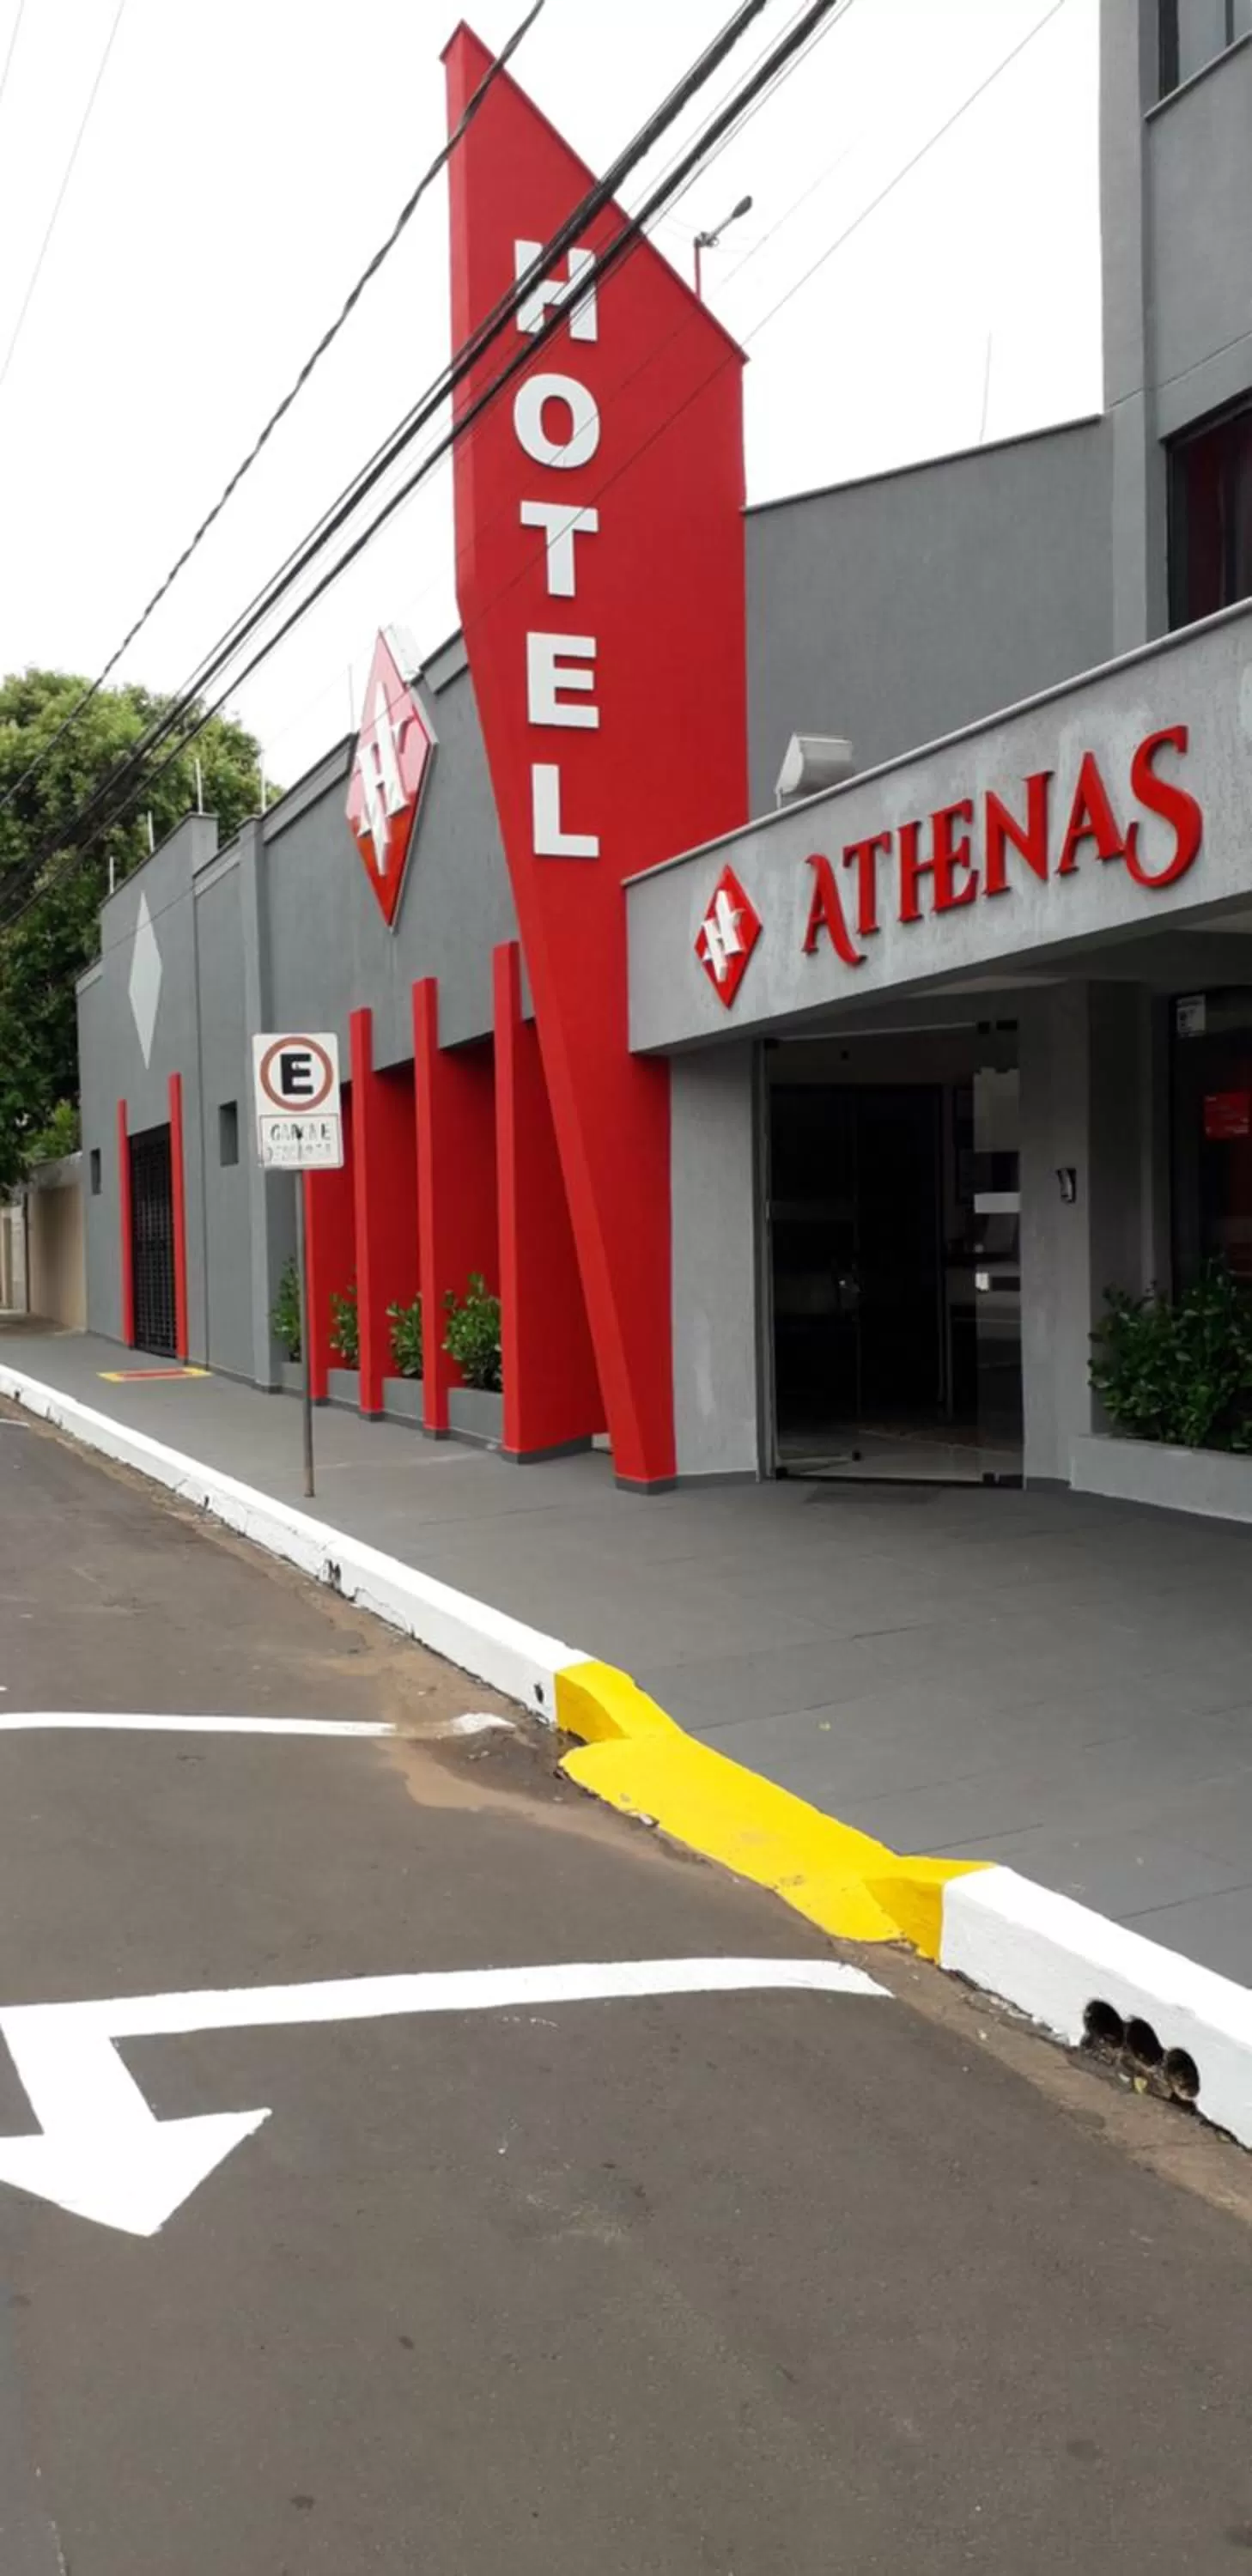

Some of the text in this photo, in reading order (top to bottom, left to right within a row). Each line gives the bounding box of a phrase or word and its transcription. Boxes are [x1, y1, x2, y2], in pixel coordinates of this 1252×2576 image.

[514, 240, 601, 859] HOTEL
[802, 725, 1204, 968] ATHENAS
[280, 1053, 314, 1095] E
